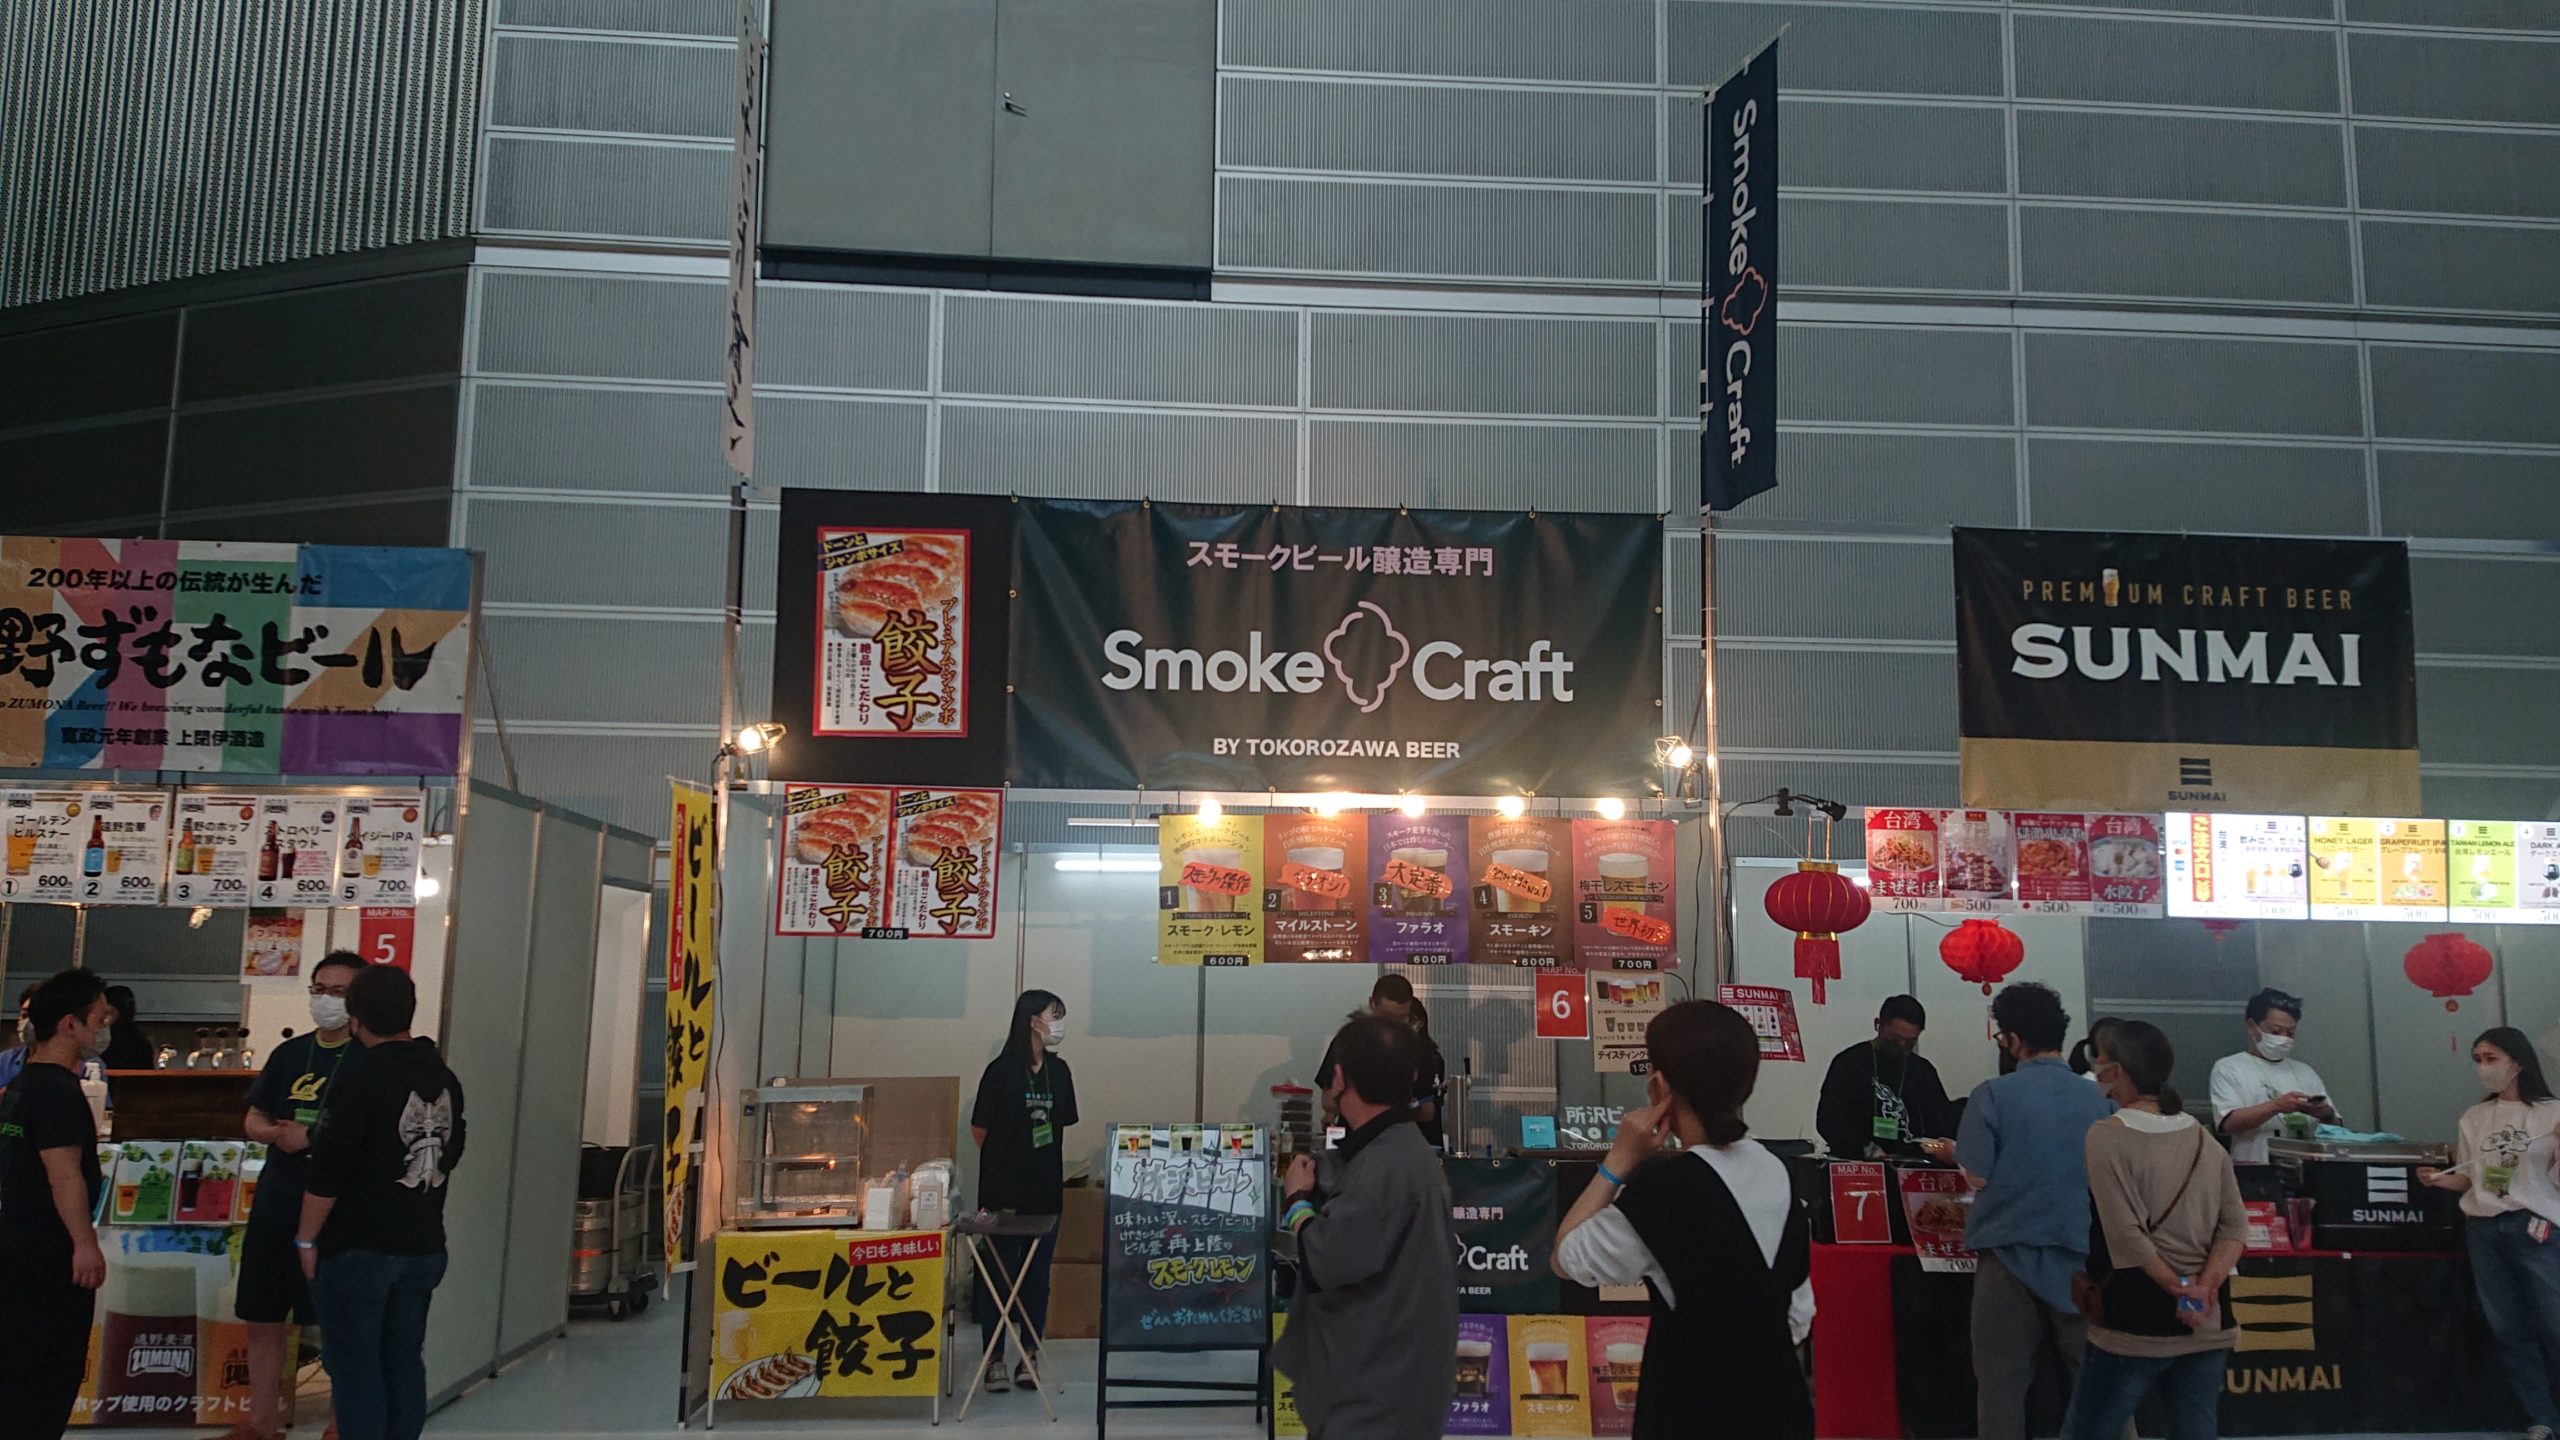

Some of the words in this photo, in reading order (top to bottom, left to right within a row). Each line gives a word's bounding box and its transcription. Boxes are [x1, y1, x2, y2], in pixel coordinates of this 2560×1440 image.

[1729, 99, 1757, 275] Smoke
[1726, 340, 1751, 468] Craft
[823, 534, 867, 553] ドーンと
[825, 542, 901, 568] ジャンボサイズ
[1186, 541, 1493, 577] スモークビール醸造専門
[28, 567, 323, 596] 200年以上の伝統が生んだ
[2183, 584, 2268, 608] CRAFT
[2287, 588, 2353, 610] BEER
[2011, 623, 2362, 687] SUNMAI
[873, 610, 943, 731] 餃子
[1101, 629, 1325, 694] Smoke
[1412, 640, 1573, 702] Craft
[8, 698, 73, 711] ZUMONA
[61, 727, 169, 745] 寛政元年創業
[1213, 738, 1241, 755] BY
[1245, 738, 1400, 758] TOKOROZAWA
[1405, 740, 1461, 758] BEER
[2168, 790, 2227, 802] SUNMAI
[15, 815, 71, 826] ゴールデン
[1884, 811, 1922, 830] 台湾
[2105, 816, 2142, 834] 台湾
[2314, 837, 2343, 845] HONEY
[2346, 837, 2373, 845] LAGER
[2380, 838, 2431, 846] GRAPEFRUIT
[39, 876, 69, 887] 600
[121, 877, 151, 888] 600
[213, 879, 242, 890] 700
[297, 880, 325, 891] 600
[379, 880, 406, 891] 700
[1389, 862, 1443, 896] 大定番
[1580, 880, 1670, 893] 梅干しスモーキン
[86, 882, 99, 895] 2
[178, 885, 190, 898] 3
[261, 886, 273, 898] 4
[344, 886, 355, 898] 5
[820, 844, 869, 932] 餃子
[930, 846, 979, 935] 餃子
[1378, 887, 1387, 902] 3
[1873, 880, 1938, 896] まぜそば
[2103, 885, 2149, 901] 水餃子
[1268, 893, 1277, 908] 2
[1479, 889, 1488, 905] 4
[367, 908, 390, 917] MAP
[392, 908, 410, 917] No.
[1584, 905, 1592, 920] 5
[1167, 924, 1255, 937] スモーク・レモン
[1275, 920, 1357, 932] マイルストーン
[1396, 922, 1445, 935] ファラオ
[1490, 924, 1552, 937] スモーキン
[868, 929, 903, 939] 700円
[374, 934, 396, 964] 5
[1209, 957, 1243, 966] 600円
[1413, 955, 1447, 964] 600円
[1521, 957, 1556, 966] 600円
[1618, 960, 1652, 970] 700円
[1542, 967, 1562, 975] MAP
[1565, 967, 1581, 975] No.
[1737, 988, 1779, 1000] SUNMAI
[1552, 990, 1571, 1019] 6
[1837, 1165, 1858, 1175] MAP
[1861, 1166, 1878, 1175] No.
[1918, 1172, 1957, 1193] 台湾
[1848, 1191, 1869, 1222] 7
[2352, 1209, 2424, 1223] SUNMAI
[851, 1240, 940, 1261] 今日も美味しい
[1467, 1244, 1529, 1271] Craft
[722, 1251, 914, 1308] ビールと
[1468, 1286, 1492, 1295] BEER
[805, 1309, 936, 1382] 餃子
[131, 1352, 192, 1374] ZUMONA
[2224, 1364, 2343, 1394] UNMAI
[1451, 1400, 1490, 1413] ファラオ
[1527, 1402, 1574, 1414] スモーキン
